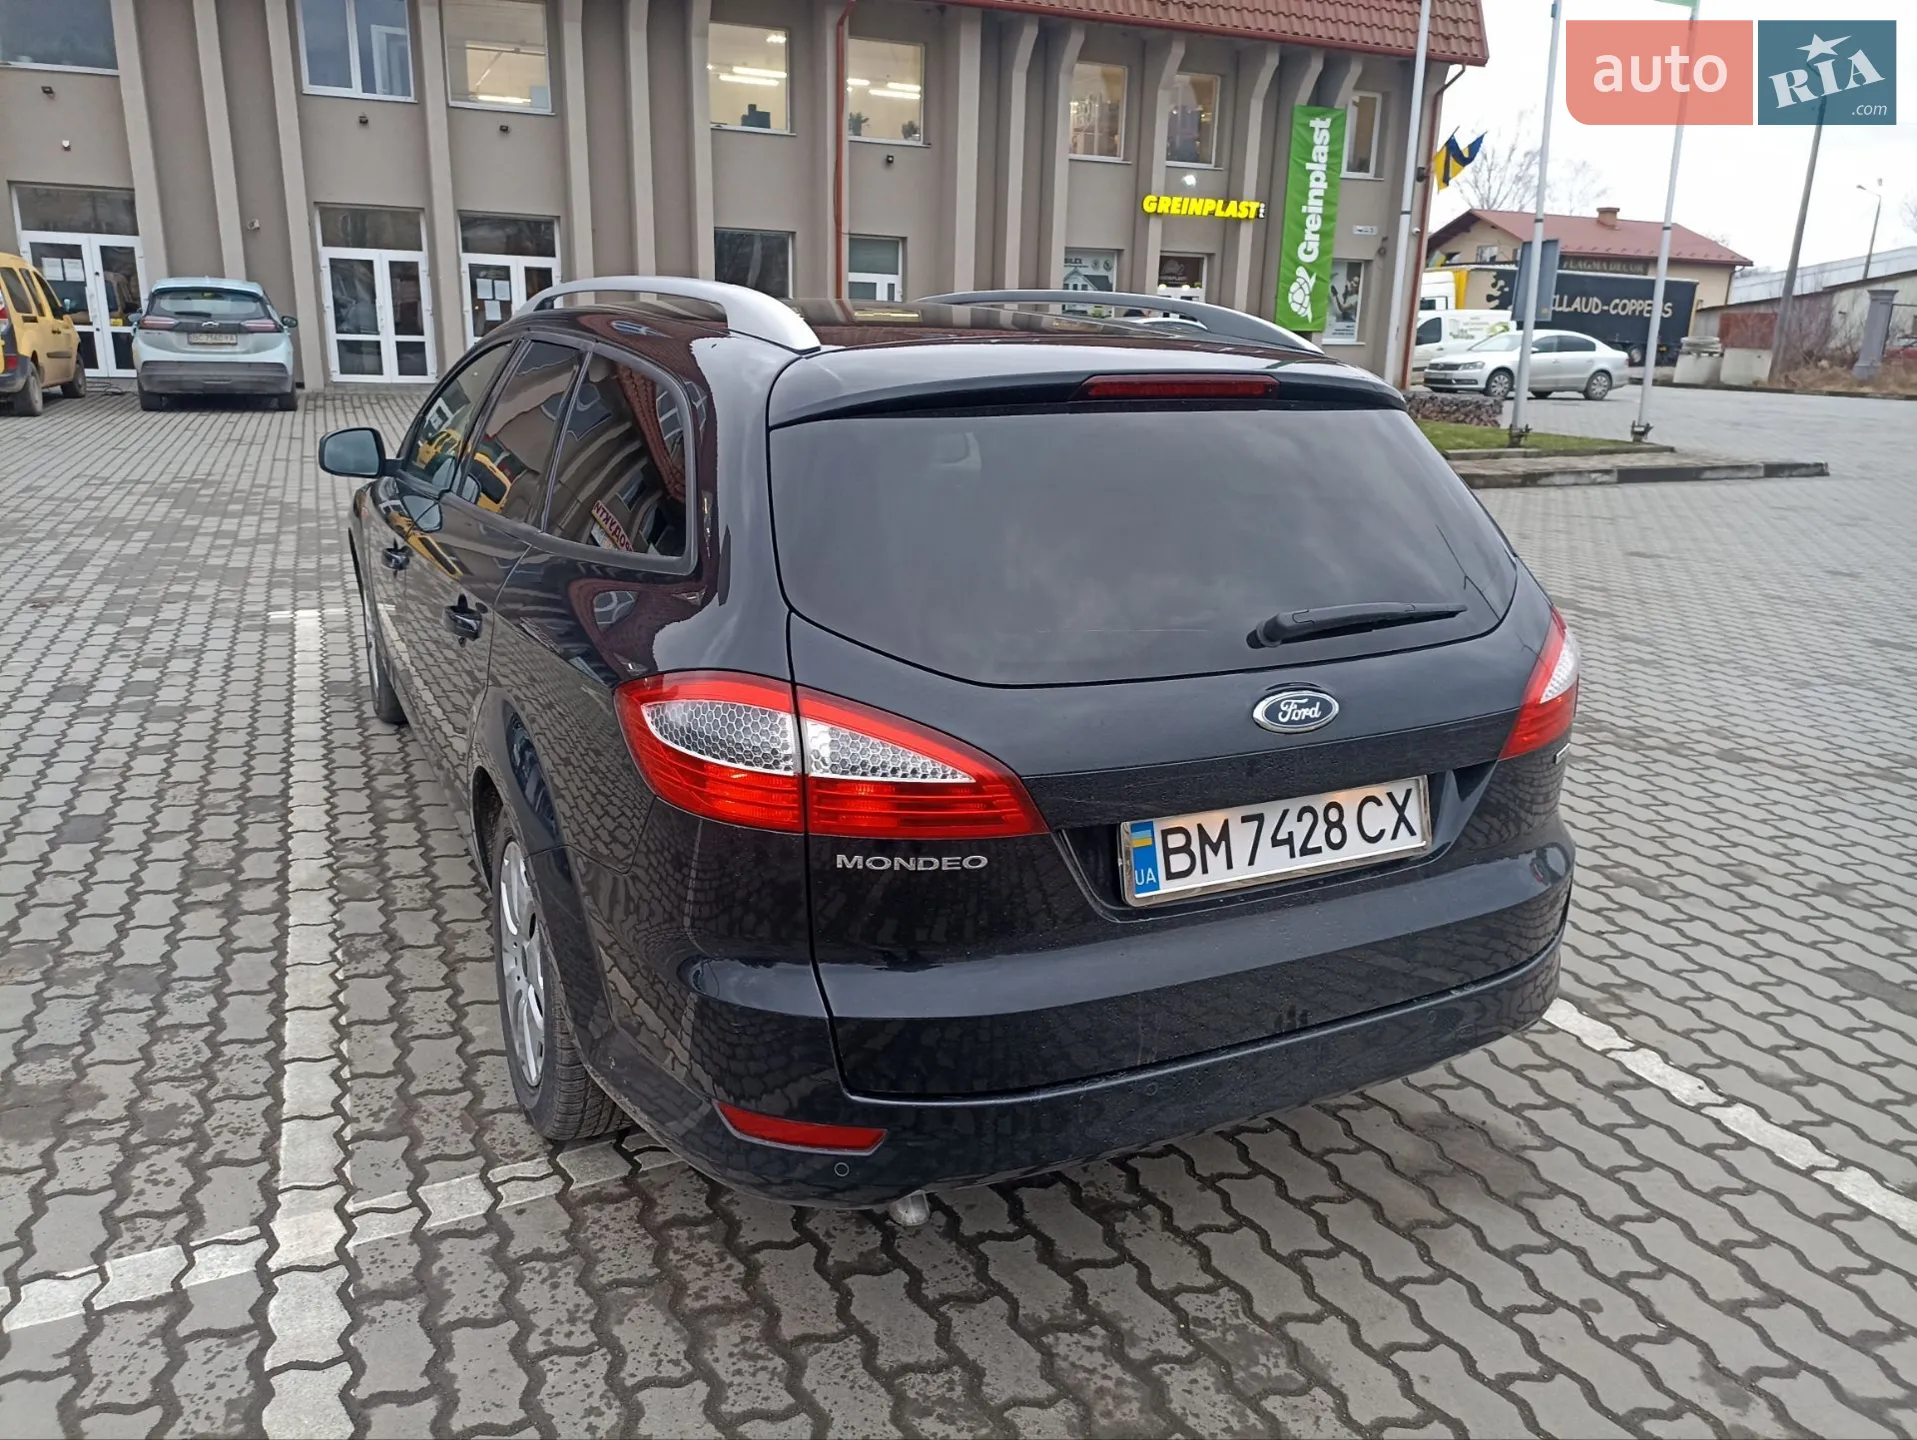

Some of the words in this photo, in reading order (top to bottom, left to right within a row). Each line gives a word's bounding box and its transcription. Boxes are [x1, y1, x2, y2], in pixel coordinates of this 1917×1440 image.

[1297, 117, 1332, 263] Greinplast
[1142, 195, 1260, 219] GREINPLAST
[1278, 698, 1321, 723] Ford
[1160, 818, 1234, 881] BM
[1240, 801, 1348, 867] 7428
[1356, 788, 1417, 844] CX
[836, 854, 988, 871] MONDEO
[1134, 868, 1157, 886] UA
